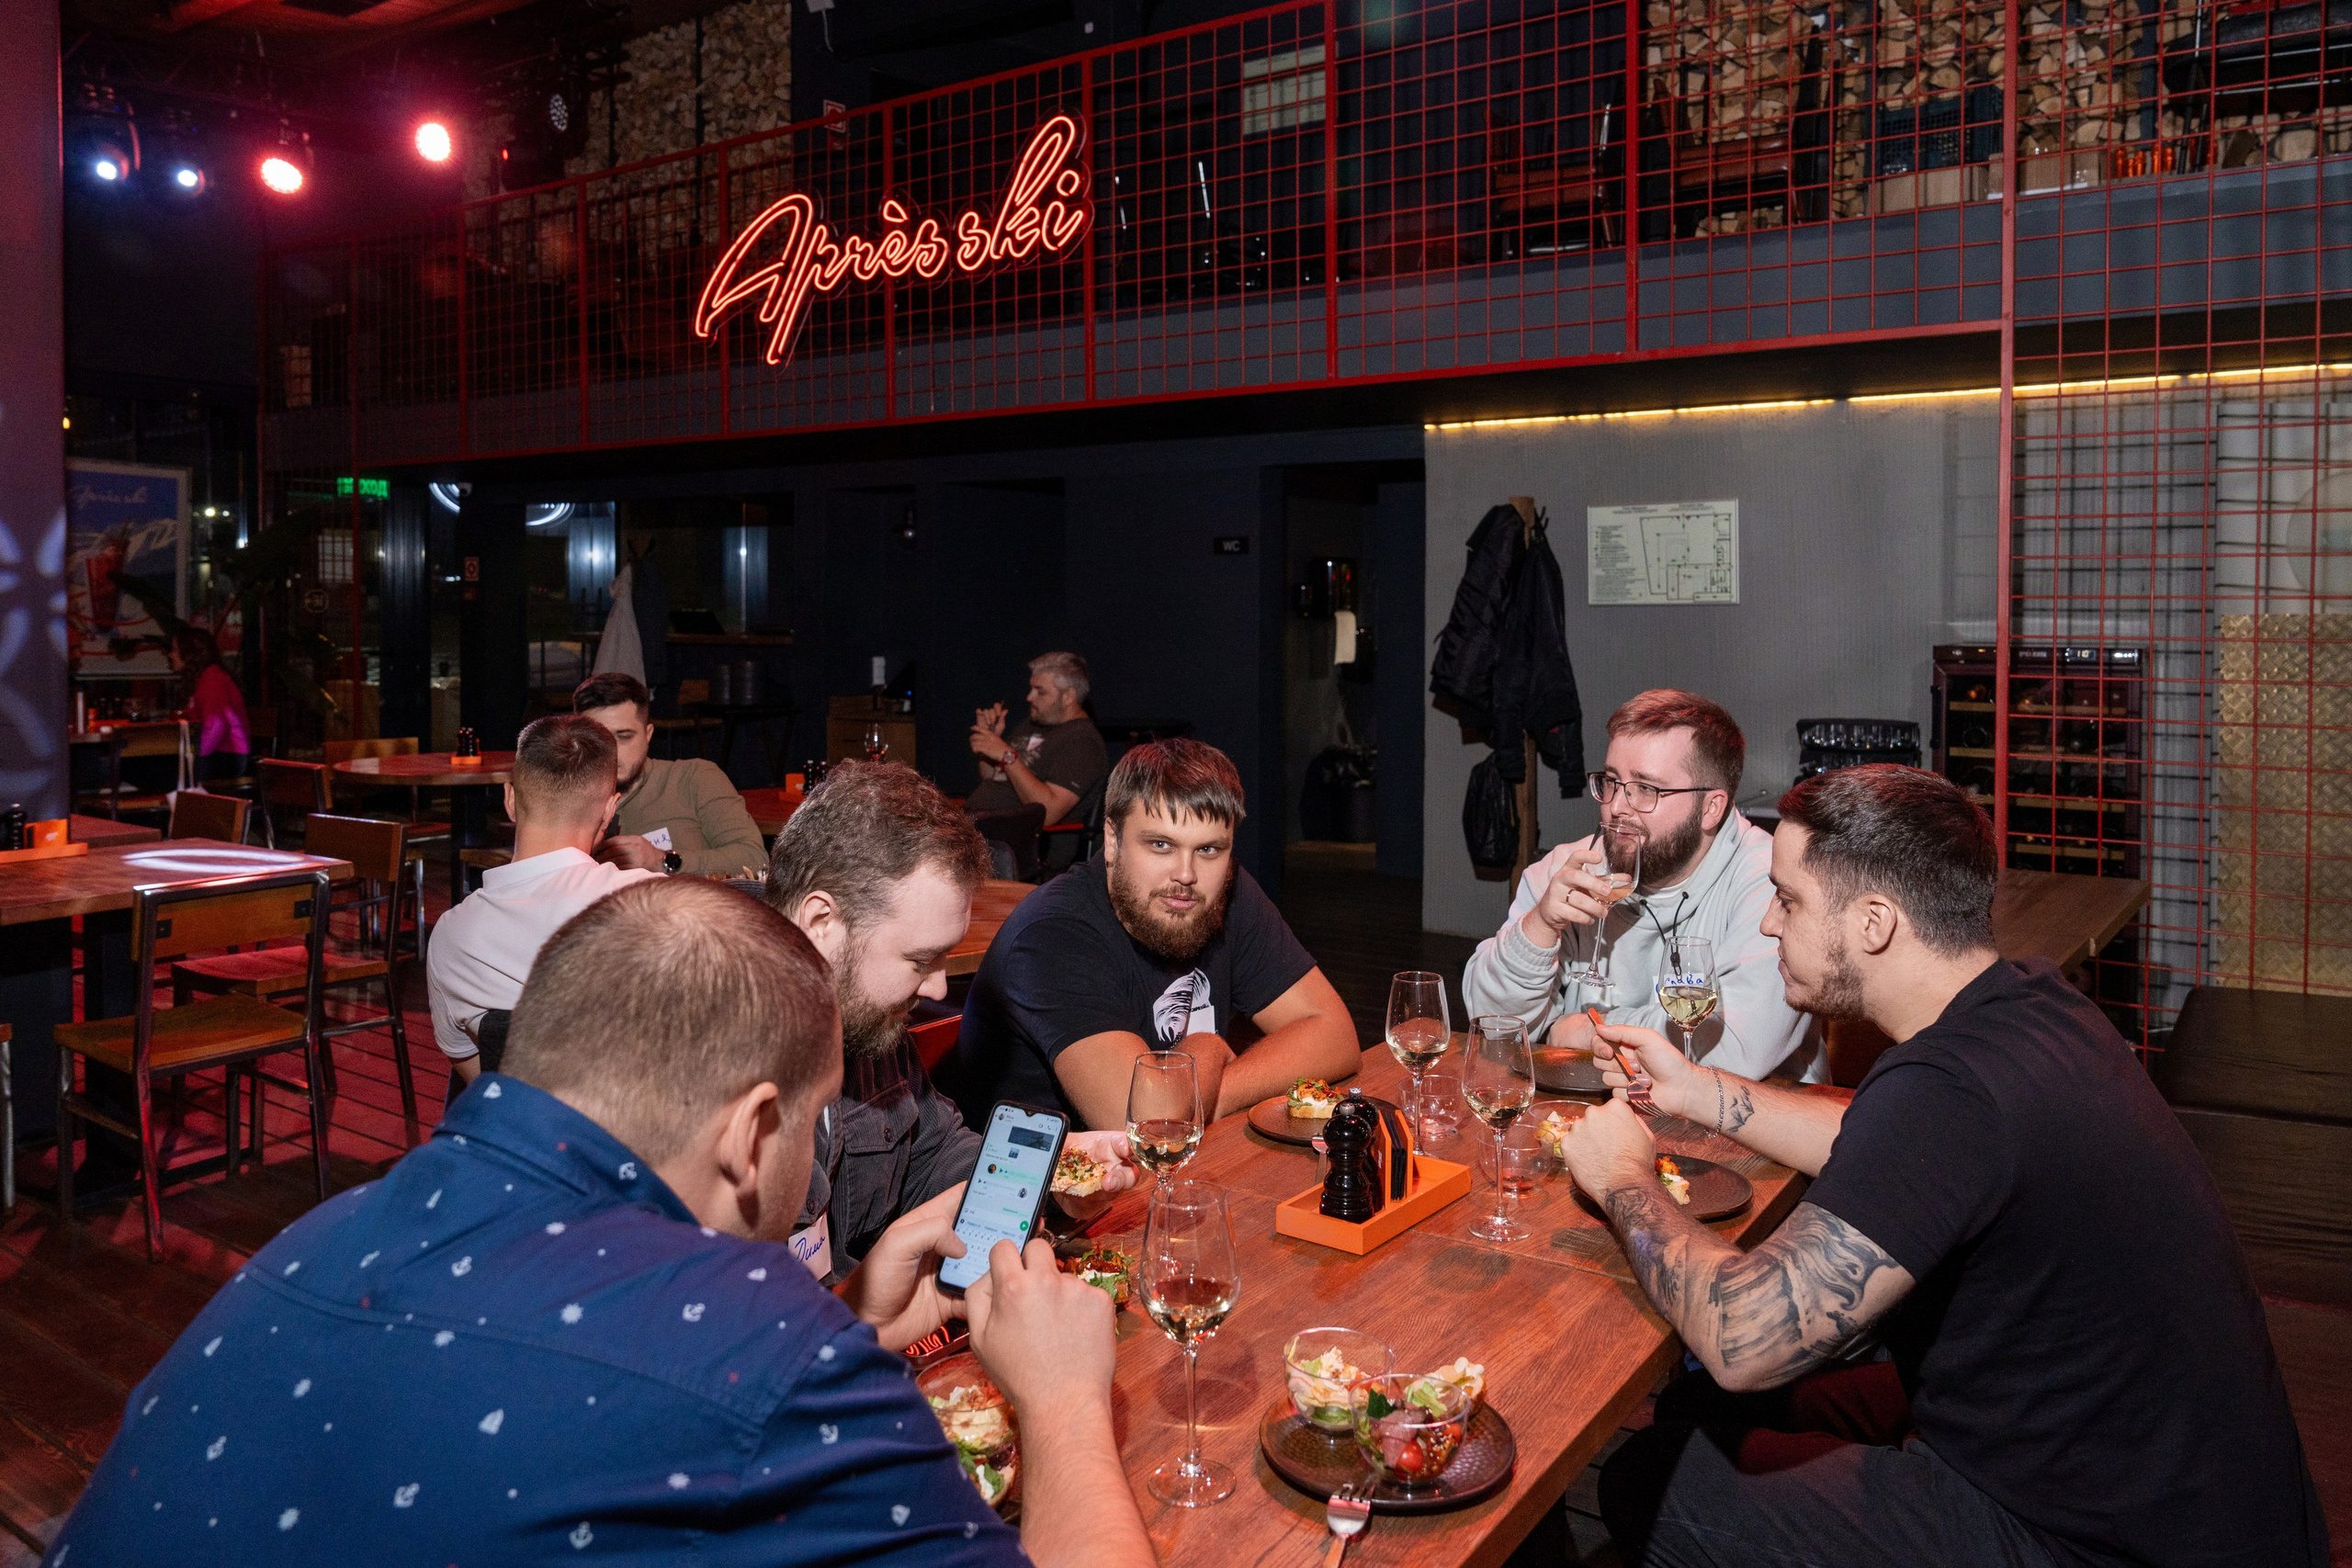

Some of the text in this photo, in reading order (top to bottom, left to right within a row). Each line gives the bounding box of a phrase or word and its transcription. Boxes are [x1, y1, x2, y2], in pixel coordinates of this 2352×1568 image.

[695, 115, 1086, 365] Après ski
[1222, 539, 1241, 552] WC
